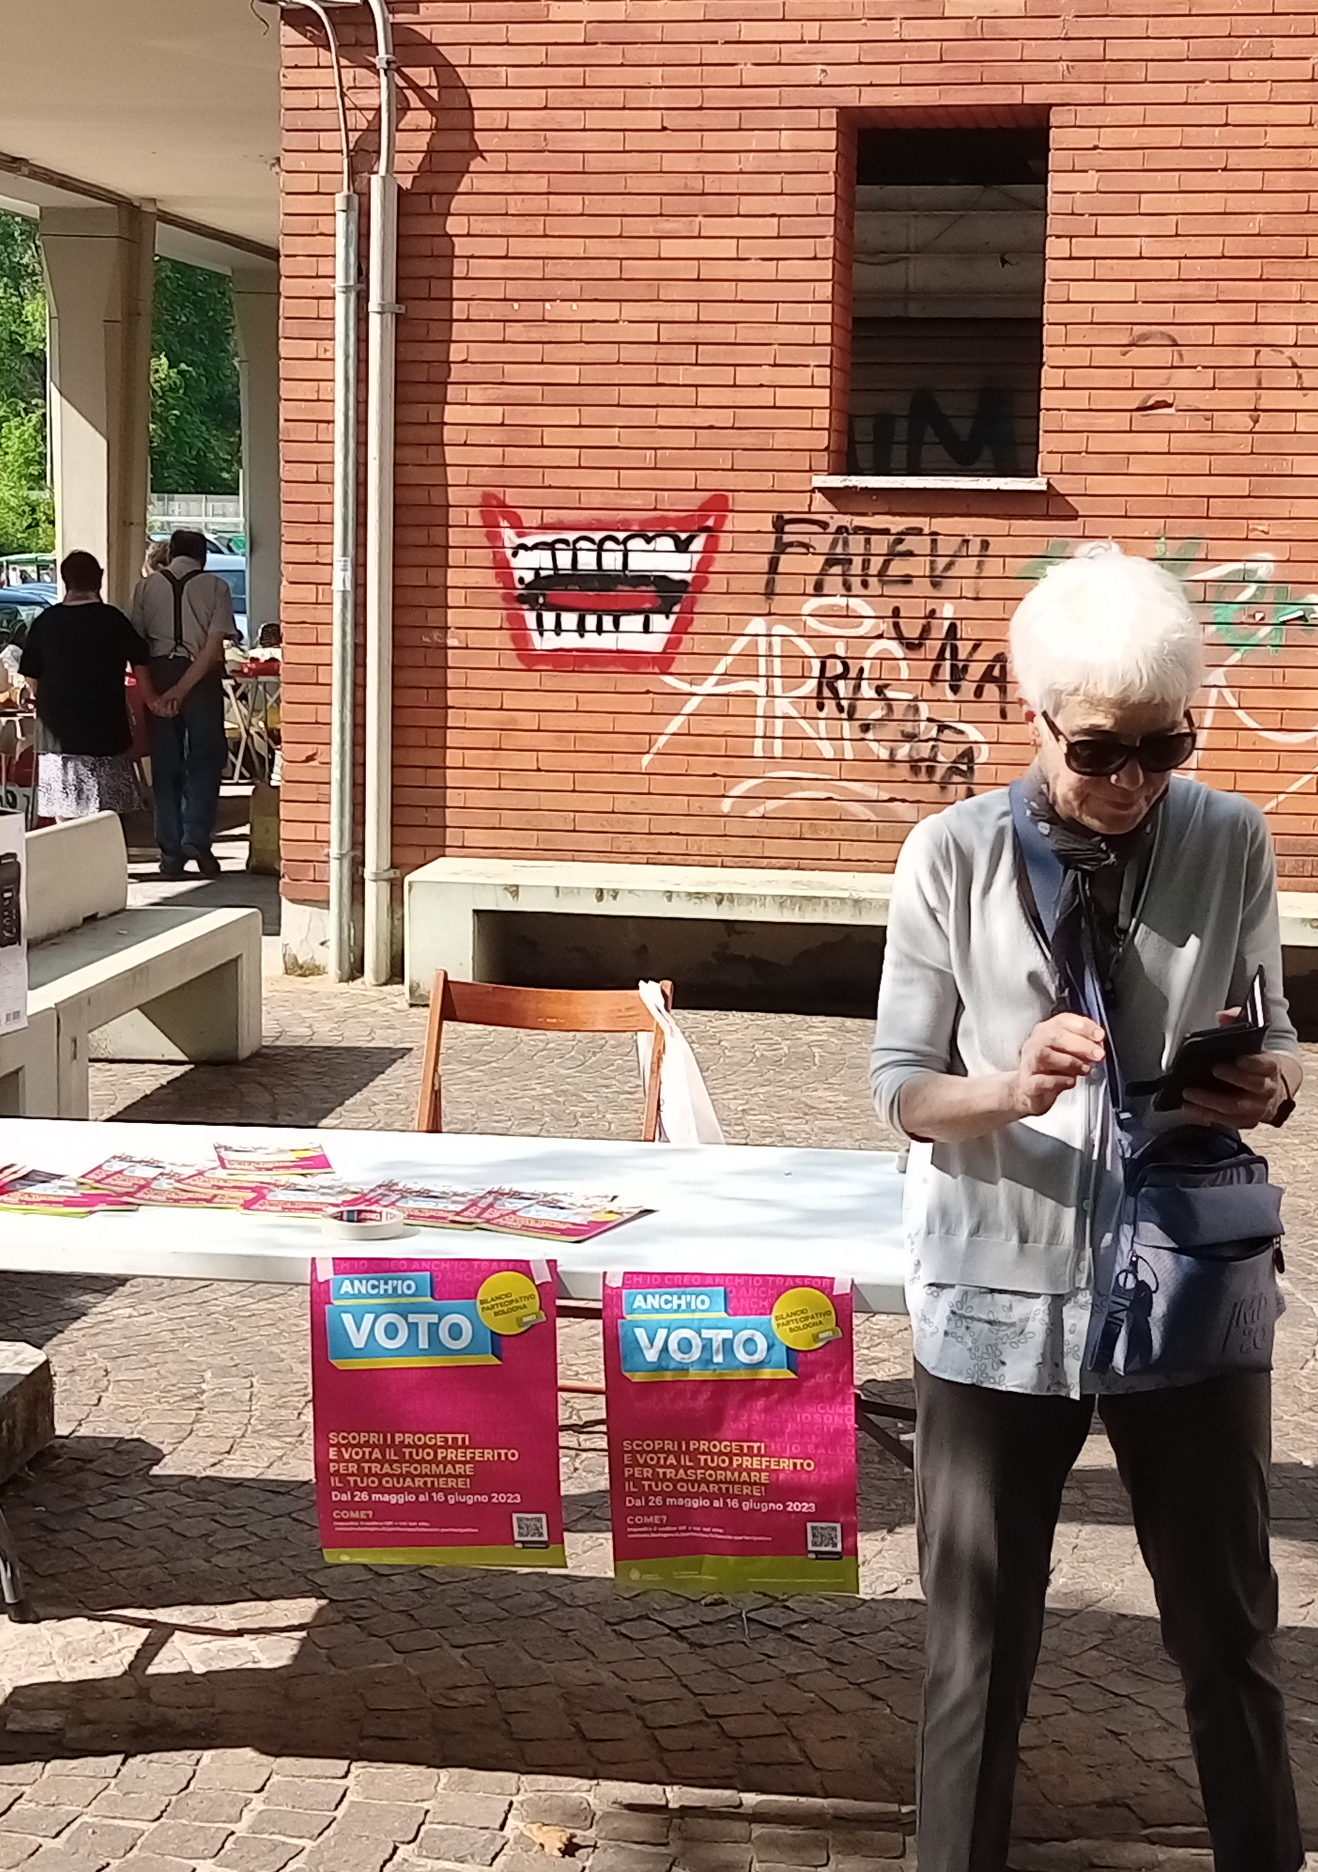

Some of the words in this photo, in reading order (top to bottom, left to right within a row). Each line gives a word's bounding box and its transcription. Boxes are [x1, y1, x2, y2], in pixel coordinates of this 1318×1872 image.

[890, 604, 1010, 719] UNA
[339, 1279, 416, 1295] ANCH'IO
[633, 1294, 711, 1309] ANCH'IO
[775, 1308, 808, 1322] BILANCIO
[776, 1310, 832, 1329] PARTECIPATIVO
[340, 1313, 473, 1350] VOTO
[789, 1320, 823, 1333] BOLOGNA
[634, 1328, 768, 1364] VOTO
[328, 1432, 383, 1445] SCOPRI
[386, 1433, 392, 1445] I
[394, 1433, 470, 1446] PROGETTI
[329, 1447, 338, 1460] E
[340, 1447, 383, 1460] VOTA
[386, 1448, 399, 1460] IL
[402, 1448, 434, 1460] TUO
[437, 1448, 519, 1461] PREFERITO
[623, 1440, 678, 1452] SCOPRI
[681, 1441, 686, 1452] I
[689, 1441, 765, 1455] PROGETTI
[329, 1462, 358, 1474] PER
[361, 1463, 475, 1476] TRASFORMARE
[624, 1454, 633, 1465] E
[635, 1454, 679, 1466] VOTA
[681, 1455, 694, 1466] IL
[697, 1455, 729, 1468] TUO
[732, 1456, 815, 1471] PREFERITO
[330, 1476, 343, 1487] IL
[346, 1476, 379, 1488] TUO
[382, 1477, 471, 1489] QUARTIERE!
[624, 1468, 653, 1479] PER
[655, 1468, 770, 1484] TRASFORMARE
[625, 1481, 638, 1492] IL
[641, 1481, 674, 1492] TUO
[677, 1482, 766, 1497] QUARTIERE!
[331, 1491, 351, 1502] Dal
[354, 1491, 369, 1502] 26
[372, 1492, 416, 1504] maggio
[418, 1492, 429, 1502] al
[431, 1492, 445, 1503] 16
[448, 1493, 489, 1505] giugno
[491, 1493, 521, 1503] 2023
[625, 1497, 645, 1507] Dal
[648, 1497, 663, 1507] 26
[666, 1497, 710, 1509] maggio
[713, 1498, 723, 1508] al
[726, 1498, 739, 1508] 16
[742, 1500, 783, 1512] giugno
[786, 1501, 816, 1513] 2023
[333, 1510, 373, 1520] COME?
[626, 1515, 667, 1524] COME?
